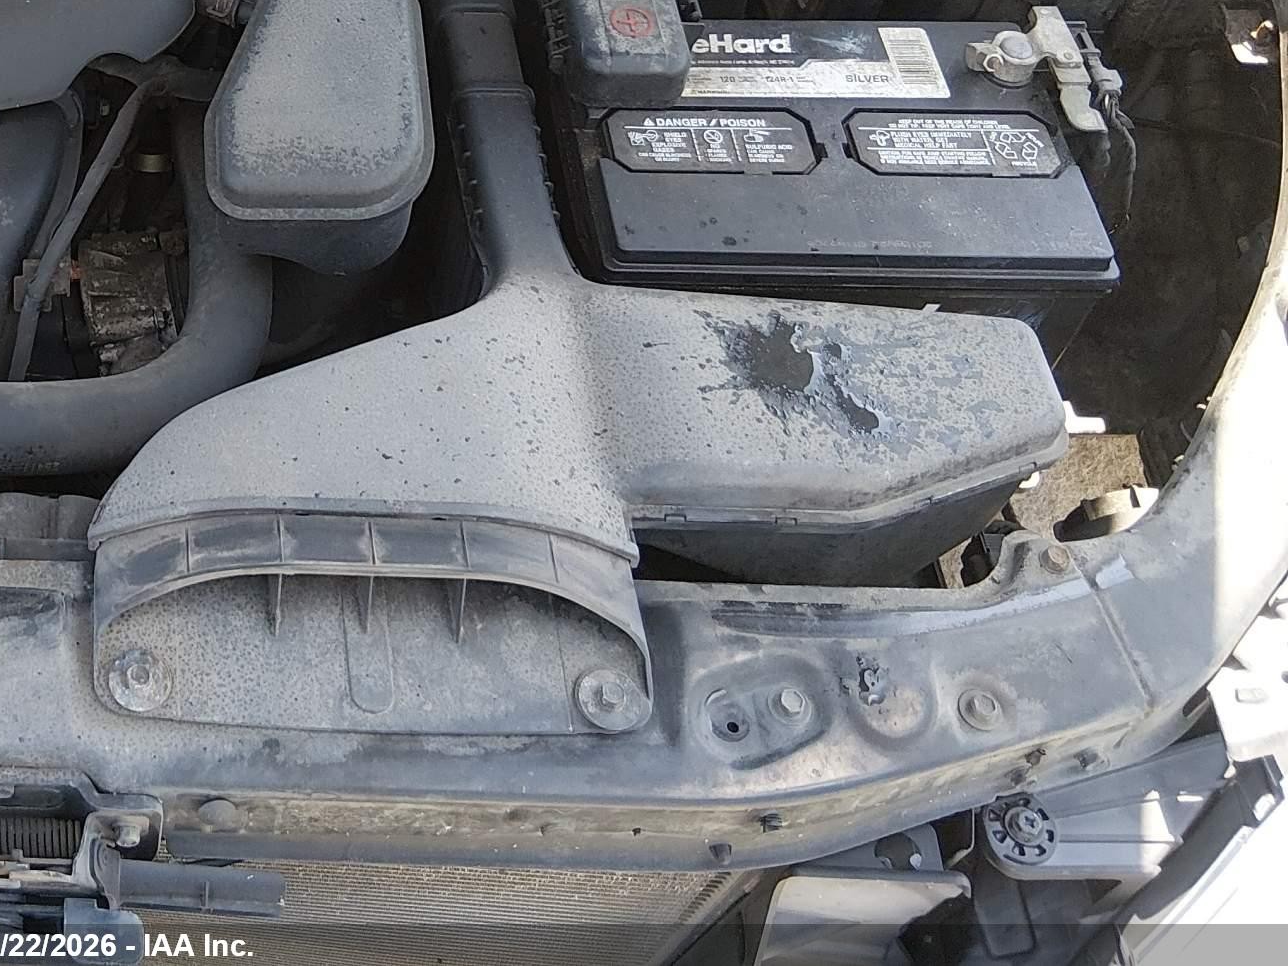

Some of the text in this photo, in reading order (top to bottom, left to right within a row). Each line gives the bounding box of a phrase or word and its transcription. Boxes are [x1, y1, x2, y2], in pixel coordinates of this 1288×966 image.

[719, 75, 736, 83] 120
[845, 74, 889, 83] SILVER
[655, 118, 707, 127] DANGER
[720, 118, 765, 127] POISON
